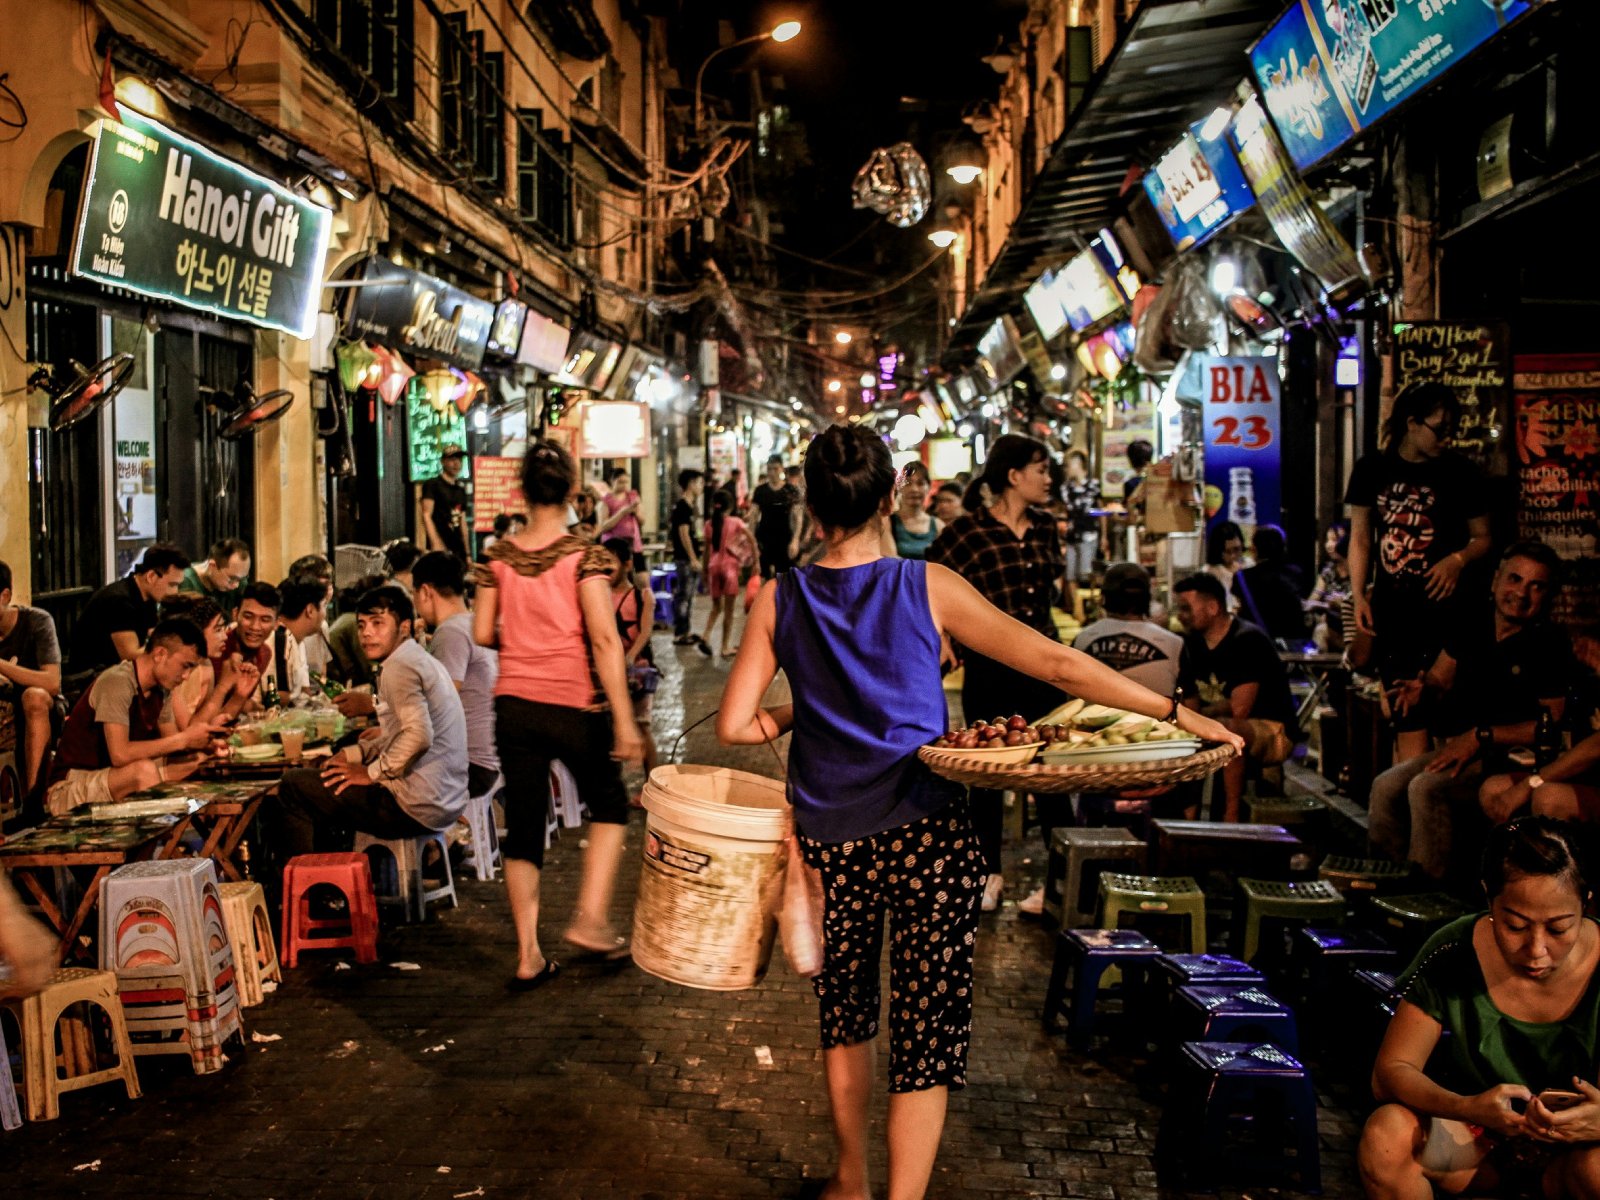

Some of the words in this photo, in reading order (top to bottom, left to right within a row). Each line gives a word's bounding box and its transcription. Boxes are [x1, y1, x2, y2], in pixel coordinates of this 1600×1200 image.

[159, 147, 251, 248] Hanoi
[252, 193, 300, 268] Gift
[175, 239, 237, 308] 하노이
[237, 262, 273, 318] 선물
[1400, 349, 1442, 374] Buy
[1443, 347, 1458, 368] 2
[1209, 364, 1272, 404] BIA
[117, 440, 150, 457] WELCOME
[1212, 416, 1273, 450] 23
[1521, 496, 1559, 508] acos
